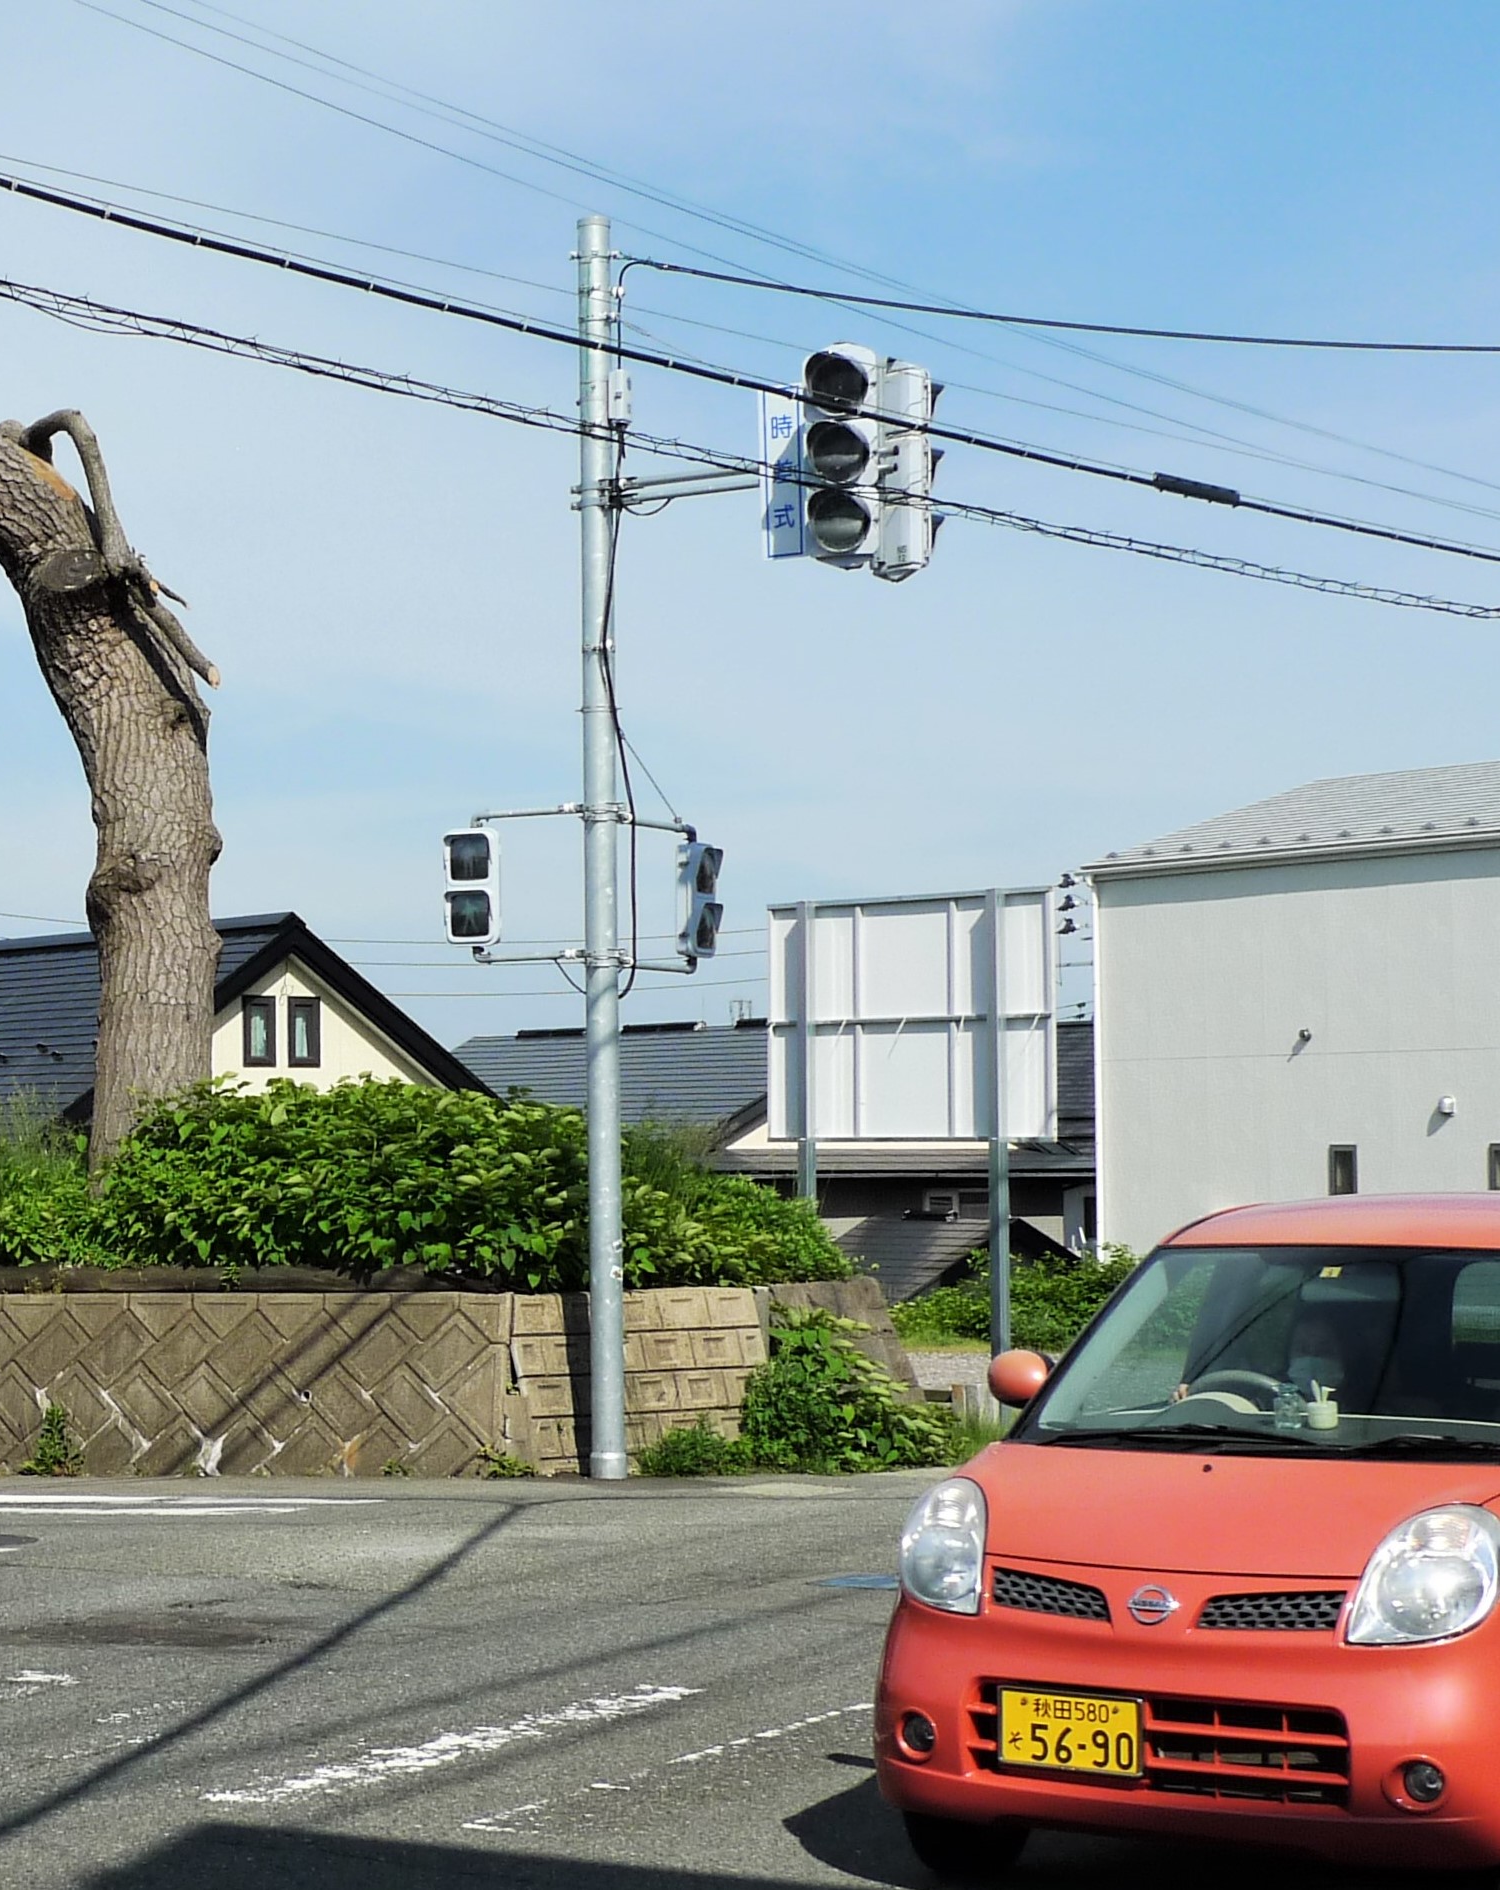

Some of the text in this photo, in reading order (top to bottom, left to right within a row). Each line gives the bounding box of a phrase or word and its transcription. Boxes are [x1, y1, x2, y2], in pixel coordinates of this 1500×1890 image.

[1033, 1698, 1109, 1723] 秋田580
[1008, 1723, 1134, 1770] そ 56-90
